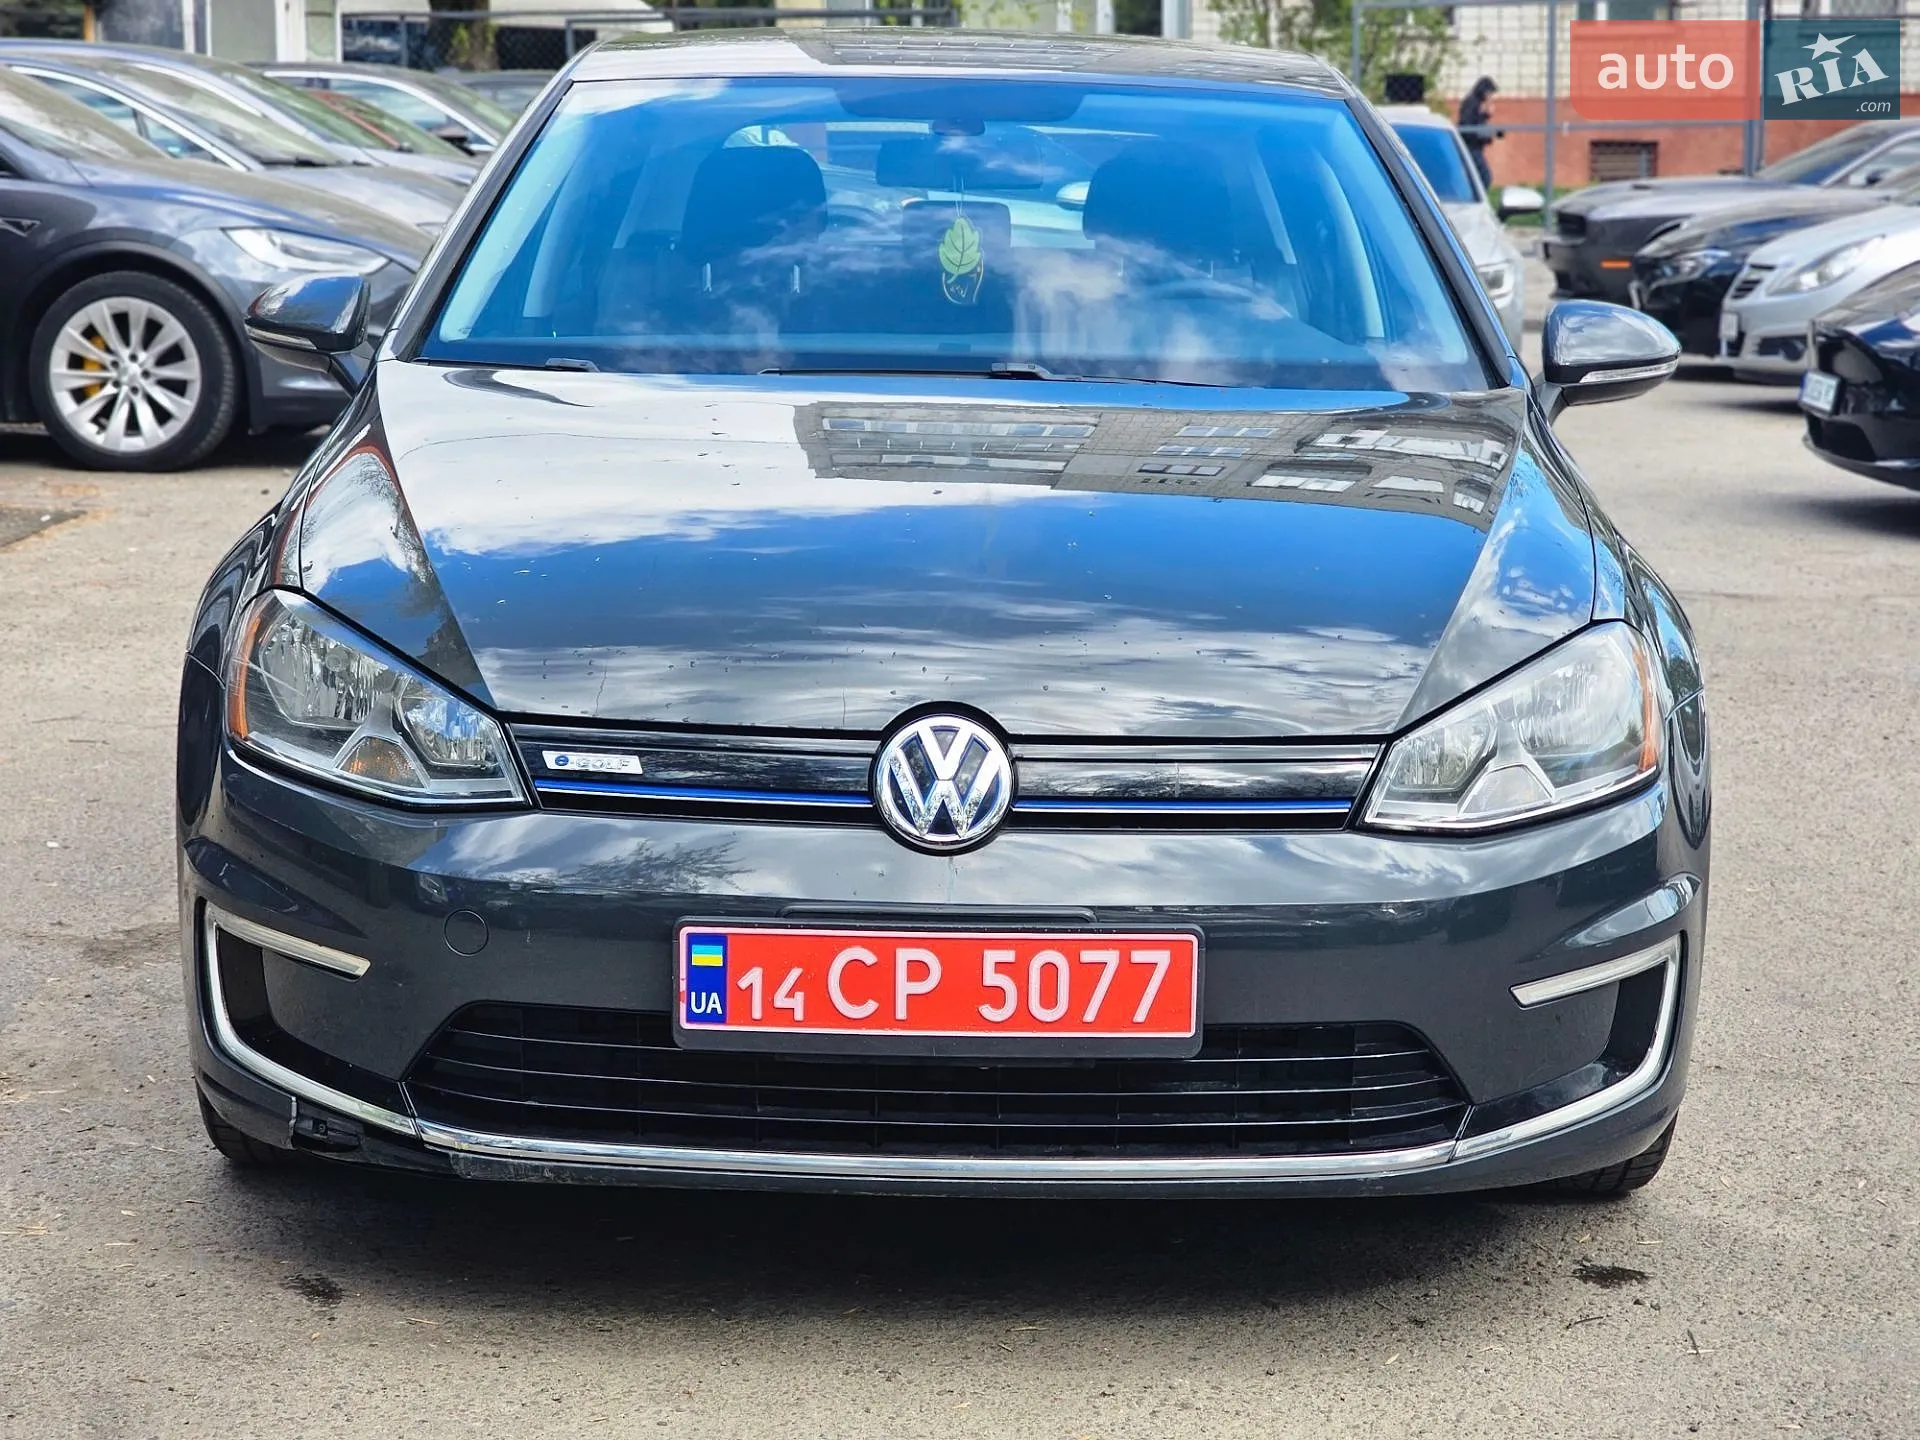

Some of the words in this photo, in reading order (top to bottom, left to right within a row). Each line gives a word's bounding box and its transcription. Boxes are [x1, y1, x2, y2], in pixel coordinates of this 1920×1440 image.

[690, 993, 722, 1015] UA
[736, 967, 804, 1021] 14
[827, 946, 942, 1021] CP
[977, 949, 1171, 1023] 5077
